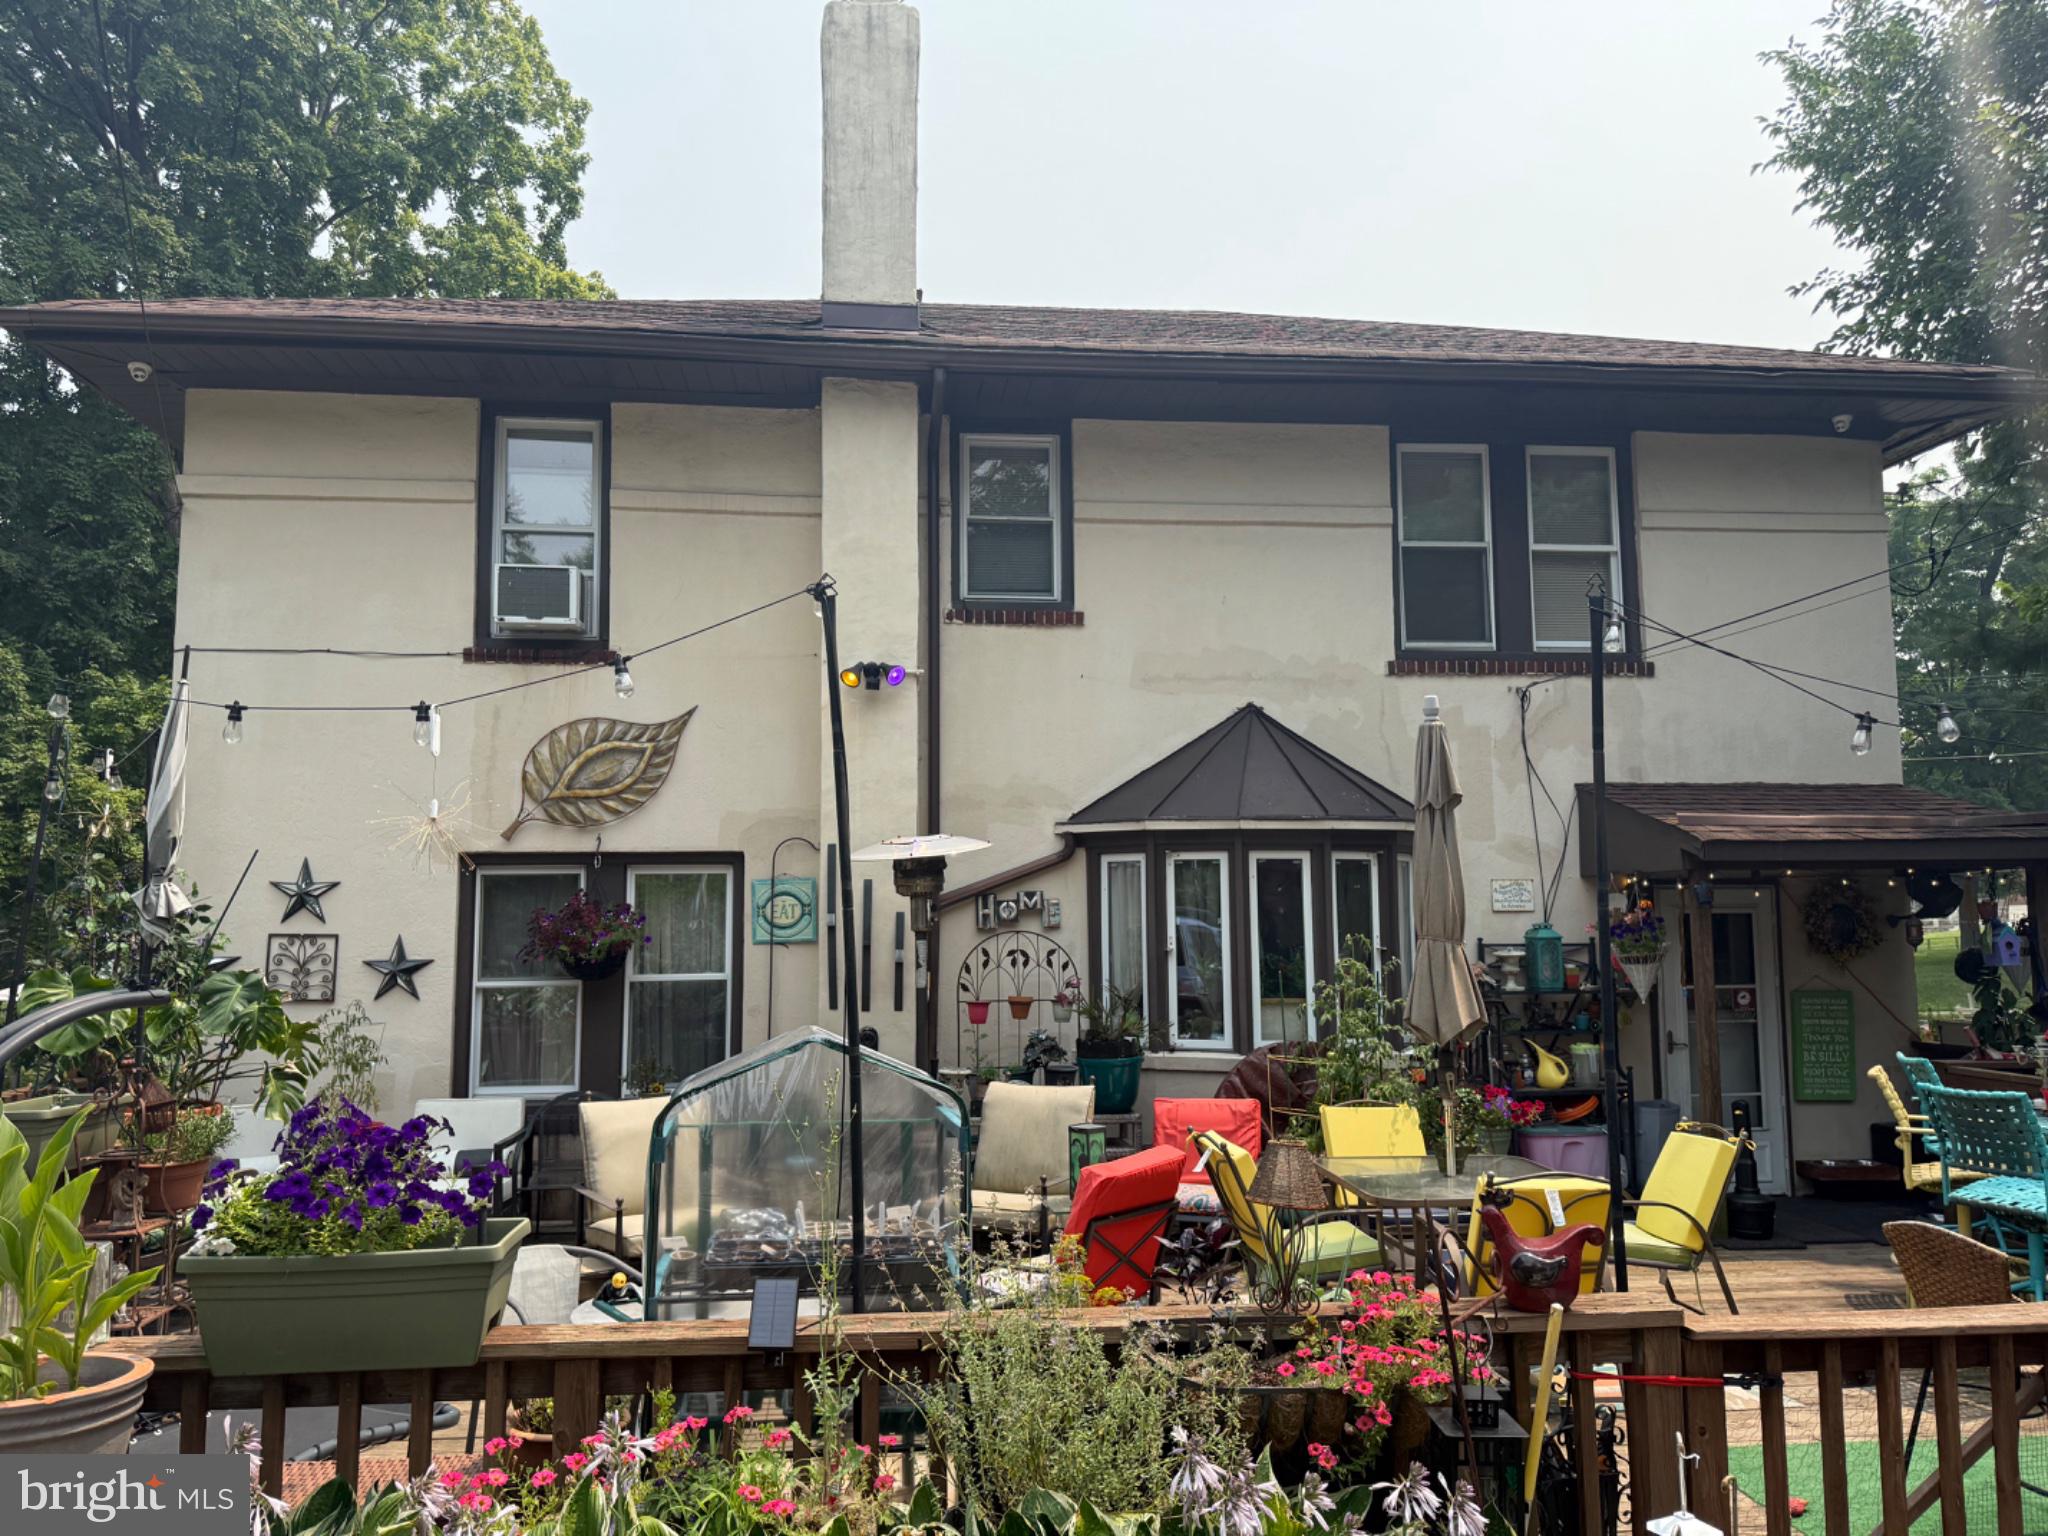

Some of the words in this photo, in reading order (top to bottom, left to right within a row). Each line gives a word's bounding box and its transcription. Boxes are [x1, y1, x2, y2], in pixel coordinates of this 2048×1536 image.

[771, 903, 798, 920] EAT
[977, 890, 1061, 928] HOME
[1803, 1051, 1817, 1062] BE
[1819, 1051, 1850, 1062] SILLY
